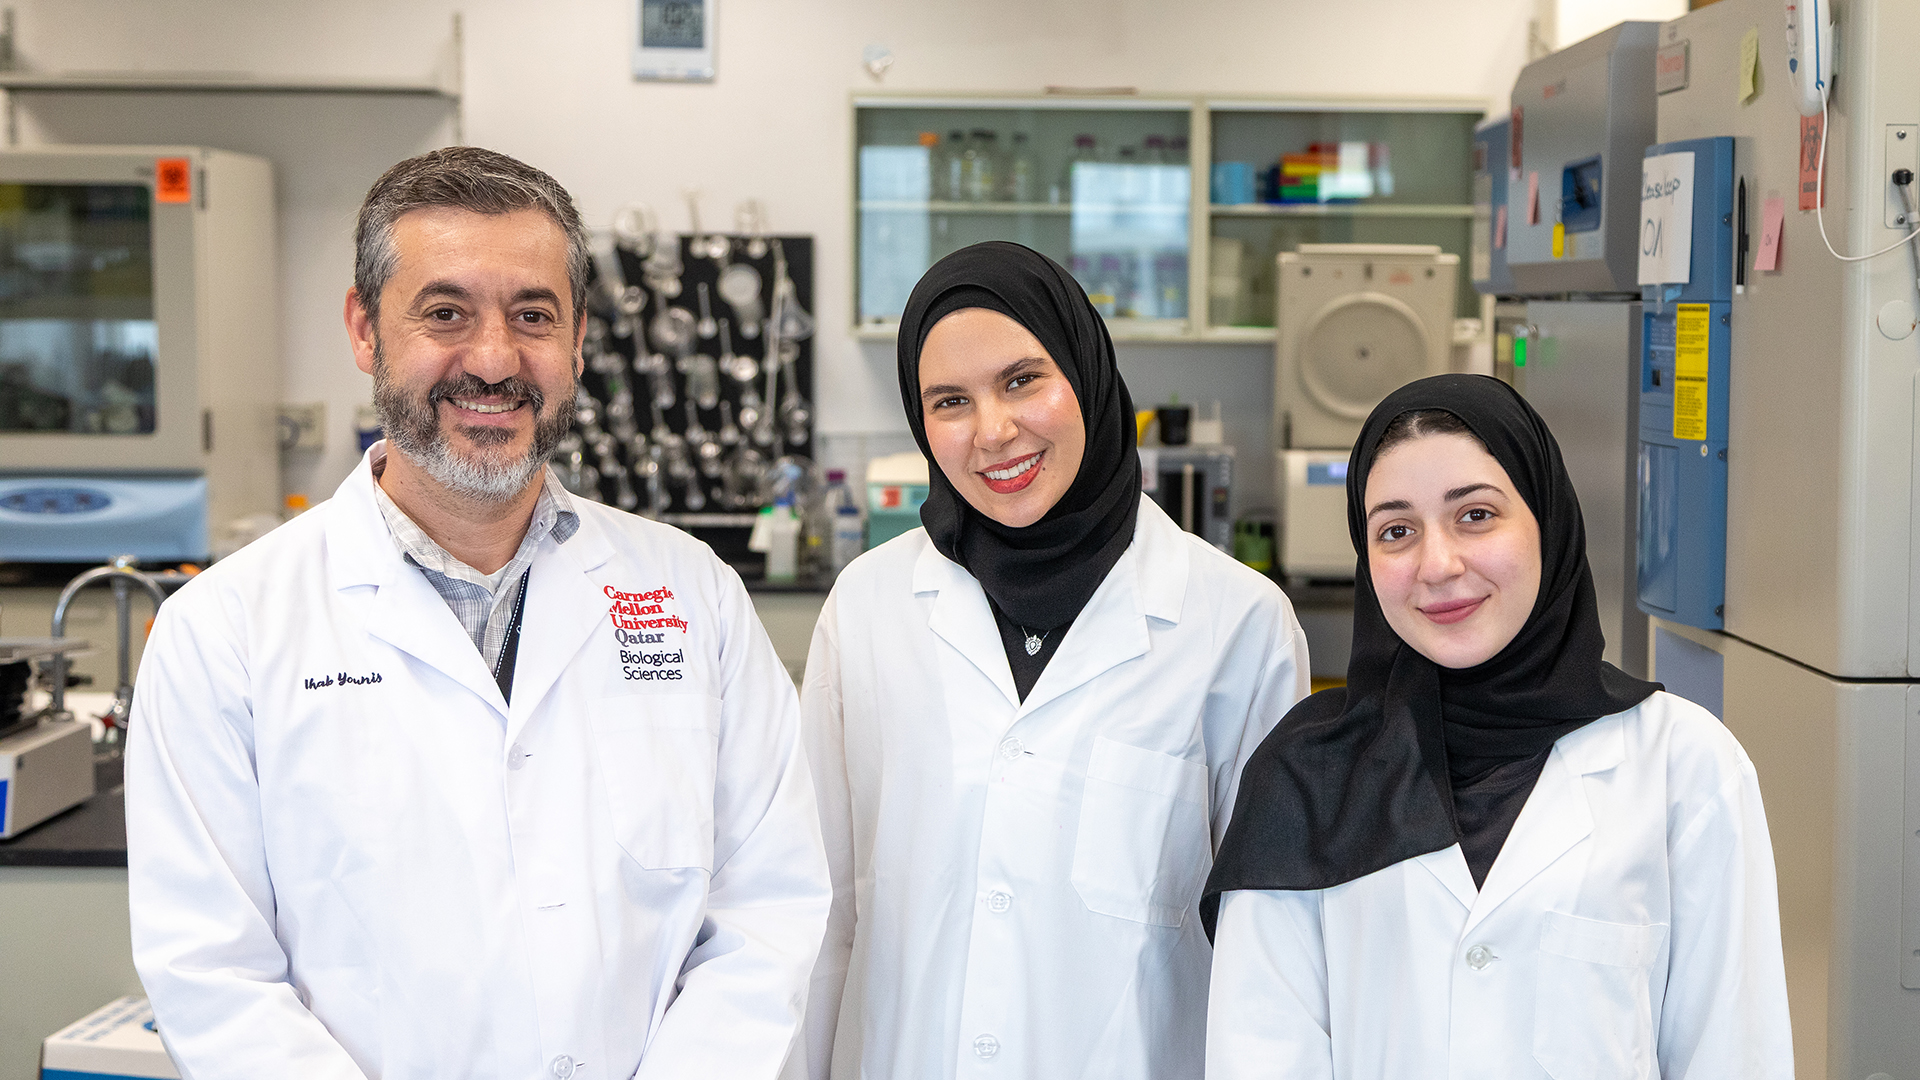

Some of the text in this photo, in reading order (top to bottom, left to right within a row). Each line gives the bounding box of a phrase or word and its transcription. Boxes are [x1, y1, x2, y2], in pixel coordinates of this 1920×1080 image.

[603, 585, 675, 604] Carnegie
[609, 600, 665, 616] Mellon
[610, 614, 689, 634] University
[614, 628, 666, 648] Qatar
[619, 648, 685, 667] Biological
[304, 671, 383, 691] Ihab Younis
[622, 666, 683, 680] Sciences
